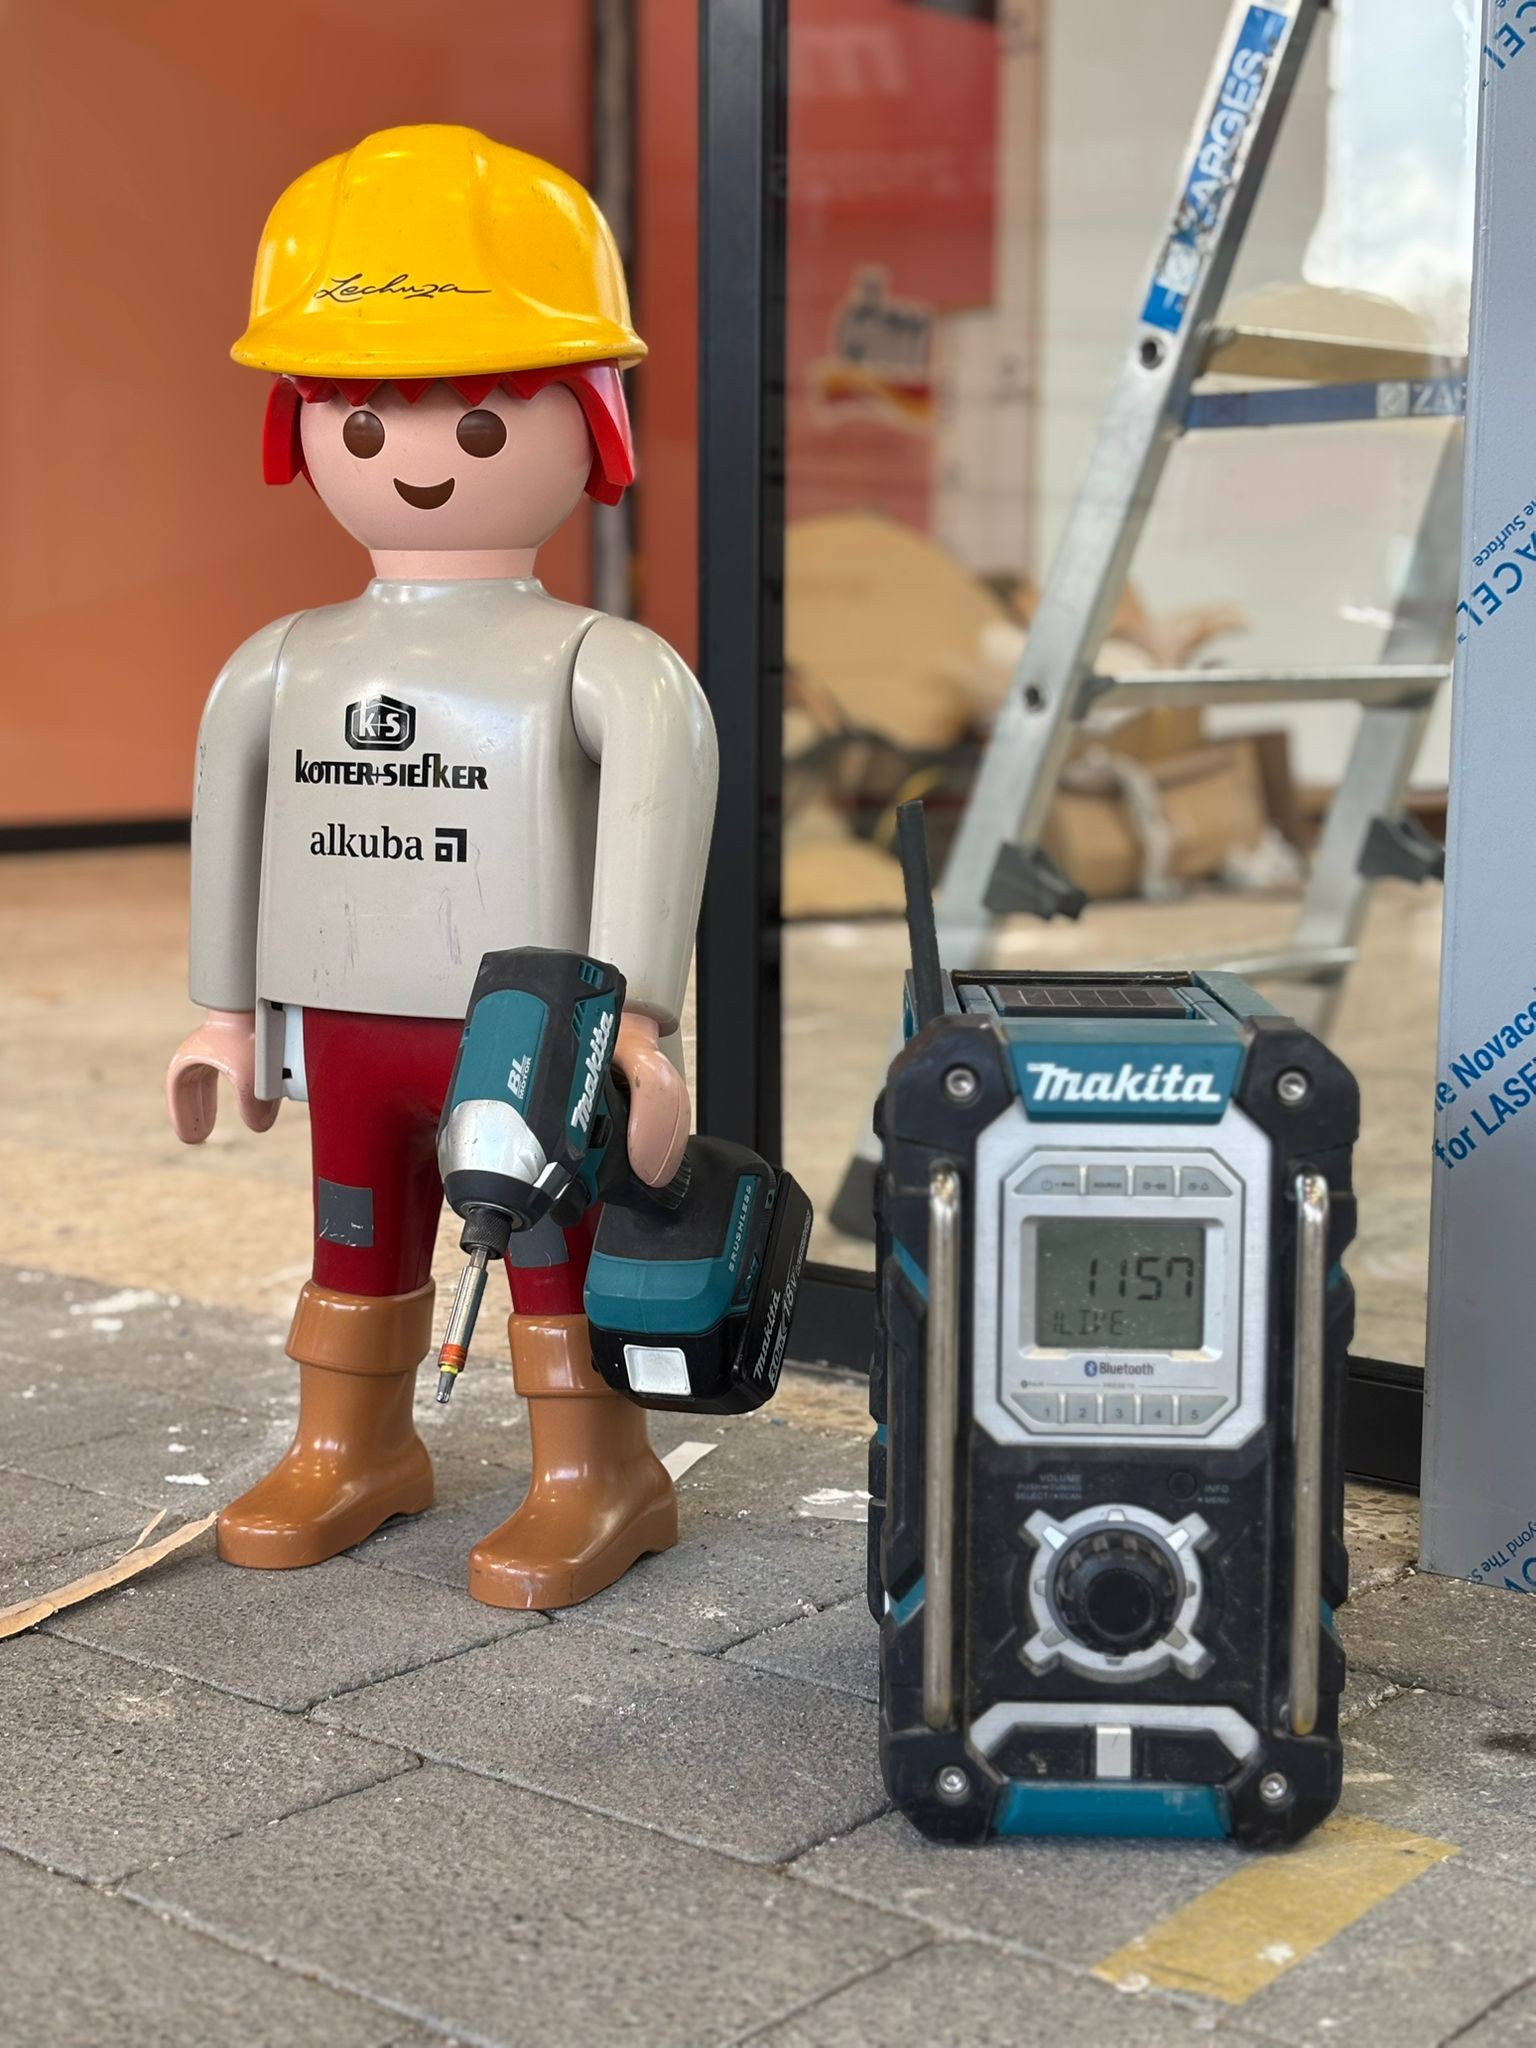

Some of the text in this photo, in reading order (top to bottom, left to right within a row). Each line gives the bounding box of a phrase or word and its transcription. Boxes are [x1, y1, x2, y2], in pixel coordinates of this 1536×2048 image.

[314, 273, 492, 303] Lechuza
[1472, 514, 1526, 567] Surface
[310, 823, 424, 861] alkuba
[507, 1058, 523, 1095] BL
[518, 1057, 532, 1099] MOTOR
[1027, 1062, 1221, 1102] Makita
[1435, 1125, 1477, 1170] for
[729, 1186, 751, 1273] BRUSHLESS
[1099, 1362, 1155, 1376] Bluetooth
[1480, 1550, 1510, 1572] The
